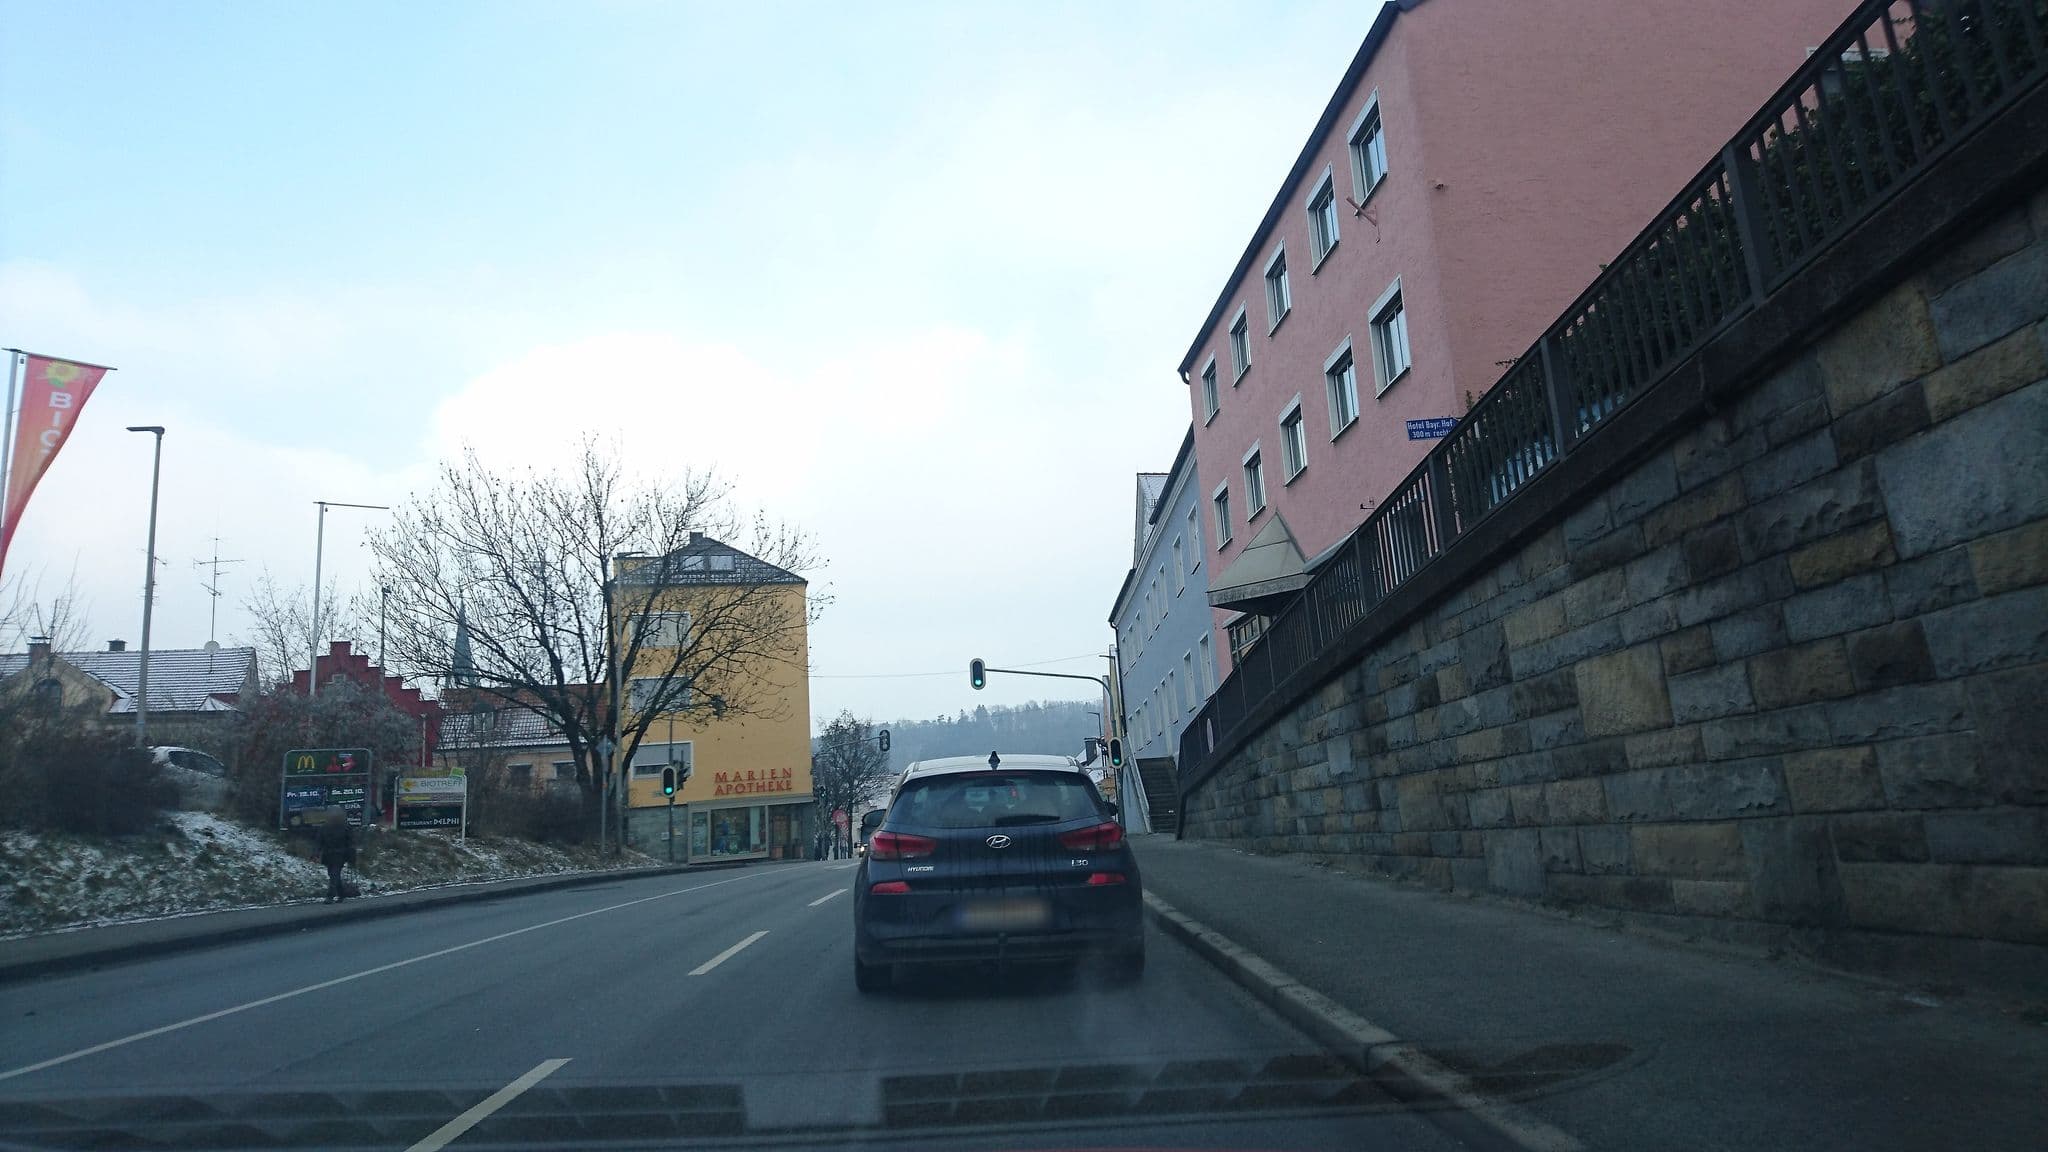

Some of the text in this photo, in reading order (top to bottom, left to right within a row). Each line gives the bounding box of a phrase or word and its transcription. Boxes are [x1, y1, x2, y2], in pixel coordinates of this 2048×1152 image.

[1407, 421, 1425, 430] Hotel
[1441, 419, 1453, 428] Hof
[1433, 428, 1451, 437] recht
[715, 768, 792, 783] MARIEN
[715, 780, 793, 795] APOTHEKE
[433, 817, 460, 826] DELPHI
[907, 865, 934, 873] HYUNDAI
